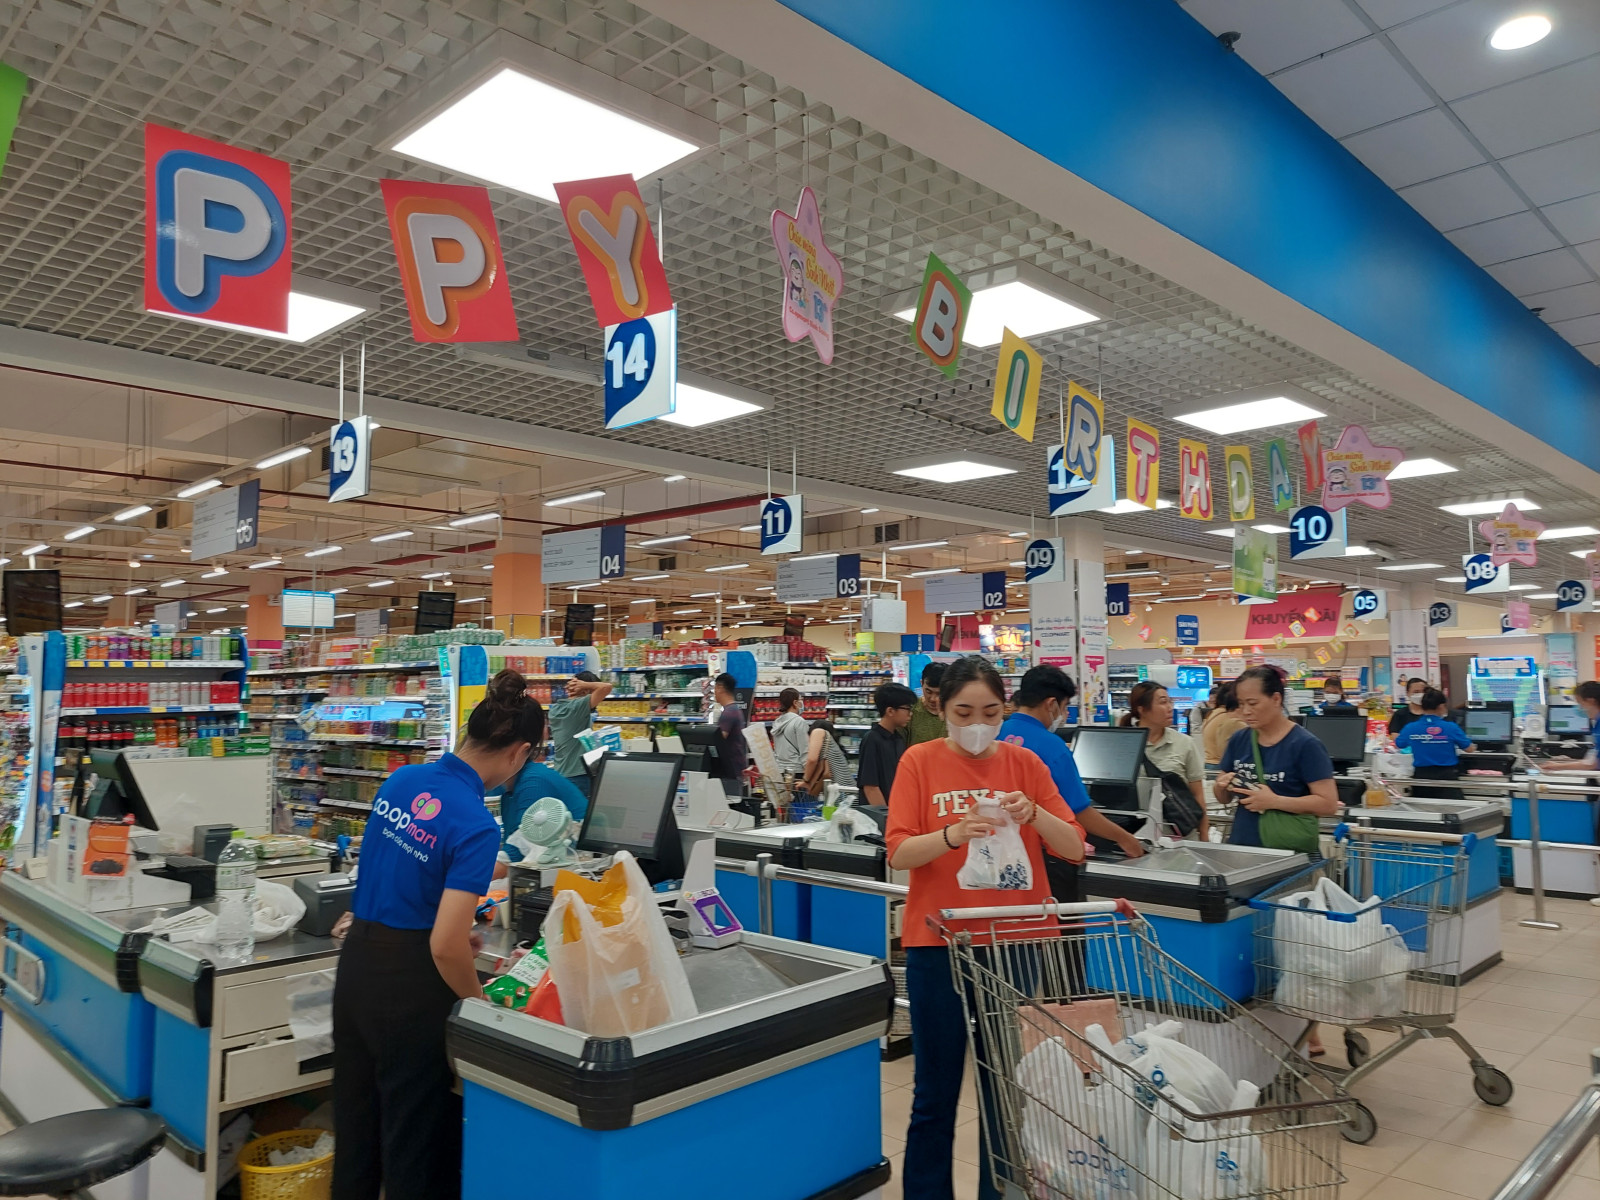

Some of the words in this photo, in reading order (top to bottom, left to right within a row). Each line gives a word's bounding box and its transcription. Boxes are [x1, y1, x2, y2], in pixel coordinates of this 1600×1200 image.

[606, 332, 649, 390] 14
[330, 436, 355, 474] 13
[237, 517, 253, 545] 05
[762, 508, 785, 535] 11
[1291, 515, 1328, 541] 10
[602, 554, 621, 576] 04
[1026, 549, 1051, 568] 09
[1465, 562, 1496, 581] 08
[838, 577, 857, 595] 03
[1557, 586, 1584, 601] 06
[984, 591, 1003, 607] 02
[1108, 601, 1124, 615] 01
[1353, 594, 1376, 611] 05
[1430, 606, 1449, 619] 03
